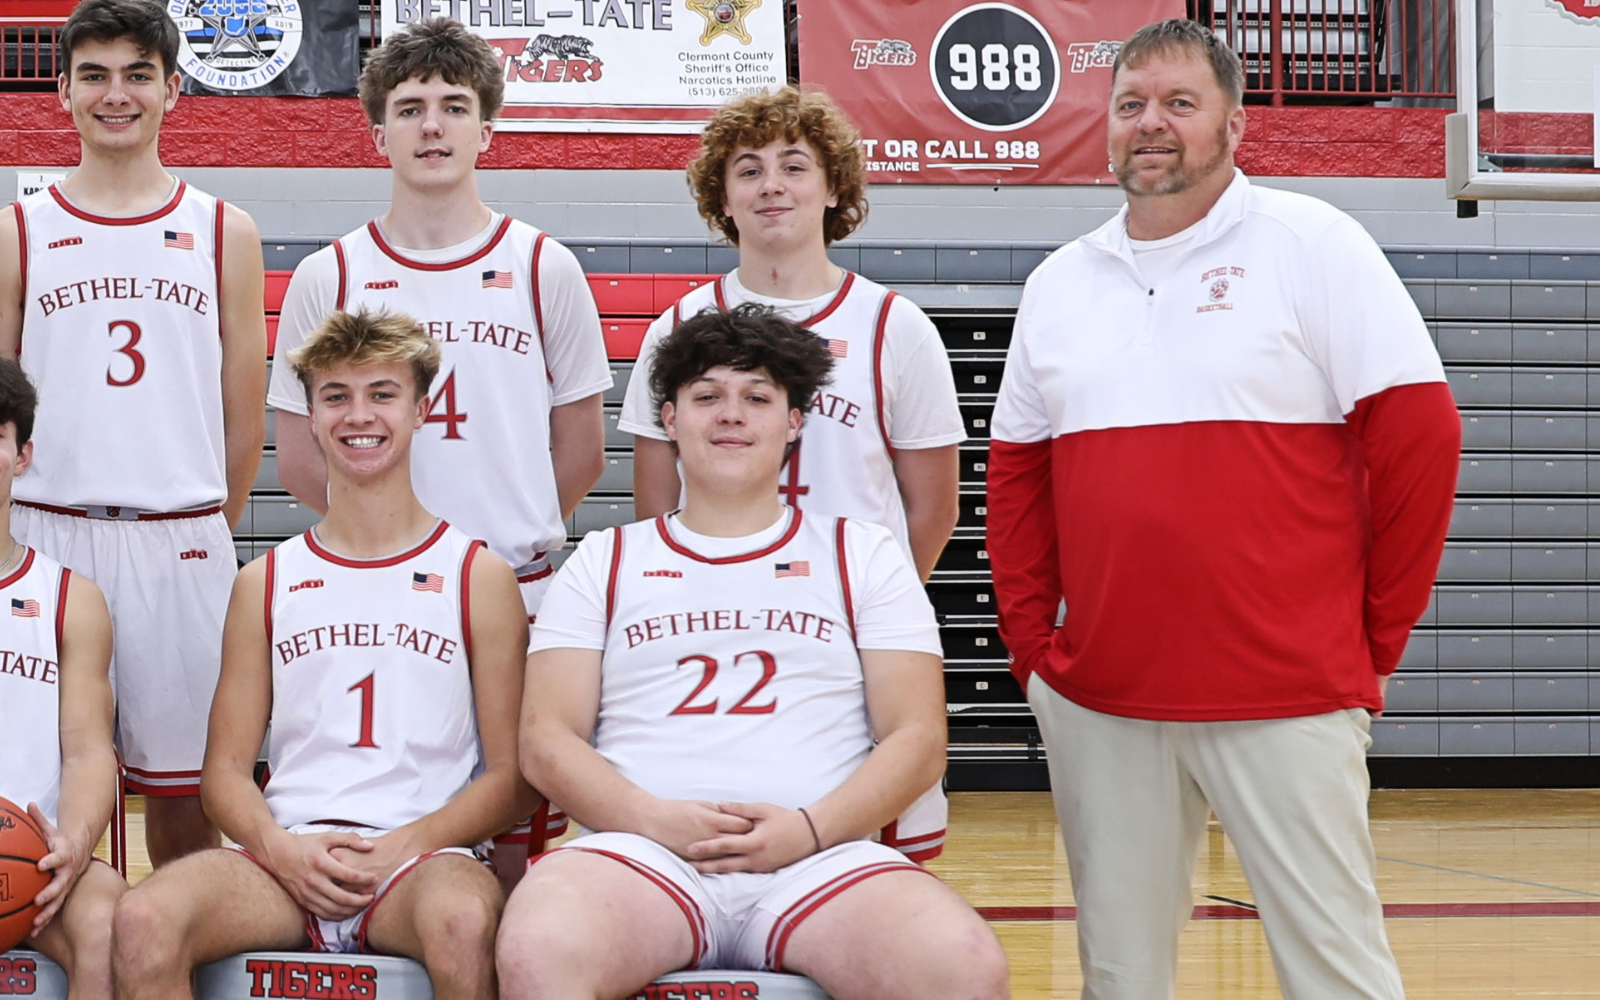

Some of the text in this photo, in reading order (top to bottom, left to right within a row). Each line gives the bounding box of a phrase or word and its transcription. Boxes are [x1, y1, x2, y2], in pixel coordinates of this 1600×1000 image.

[396, 0, 674, 31] BETHEL-TATE
[185, 55, 286, 87] FOUNDATION
[485, 37, 605, 82] TIGERS
[678, 51, 774, 62] Clermont County
[685, 63, 769, 74] Sheriff's Office
[851, 39, 917, 70] TIGERS
[949, 44, 1042, 91] 988
[1067, 42, 1115, 73] TIGE
[679, 75, 777, 85] Narcotics Hotline
[688, 88, 716, 97] (513)
[884, 139, 919, 158] OR
[925, 139, 989, 159] CALL
[994, 140, 1040, 159] 988
[866, 161, 920, 172] ISTANCE
[37, 277, 210, 318] BETHEL-TATE
[106, 319, 146, 387] 3
[418, 320, 532, 355] EL-TATE
[275, 623, 458, 666] BETHEL-TATE
[623, 609, 835, 650] BETHEL-TATE
[667, 650, 779, 716] 22
[346, 668, 382, 750] 1
[246, 959, 378, 1000] TIGERS
